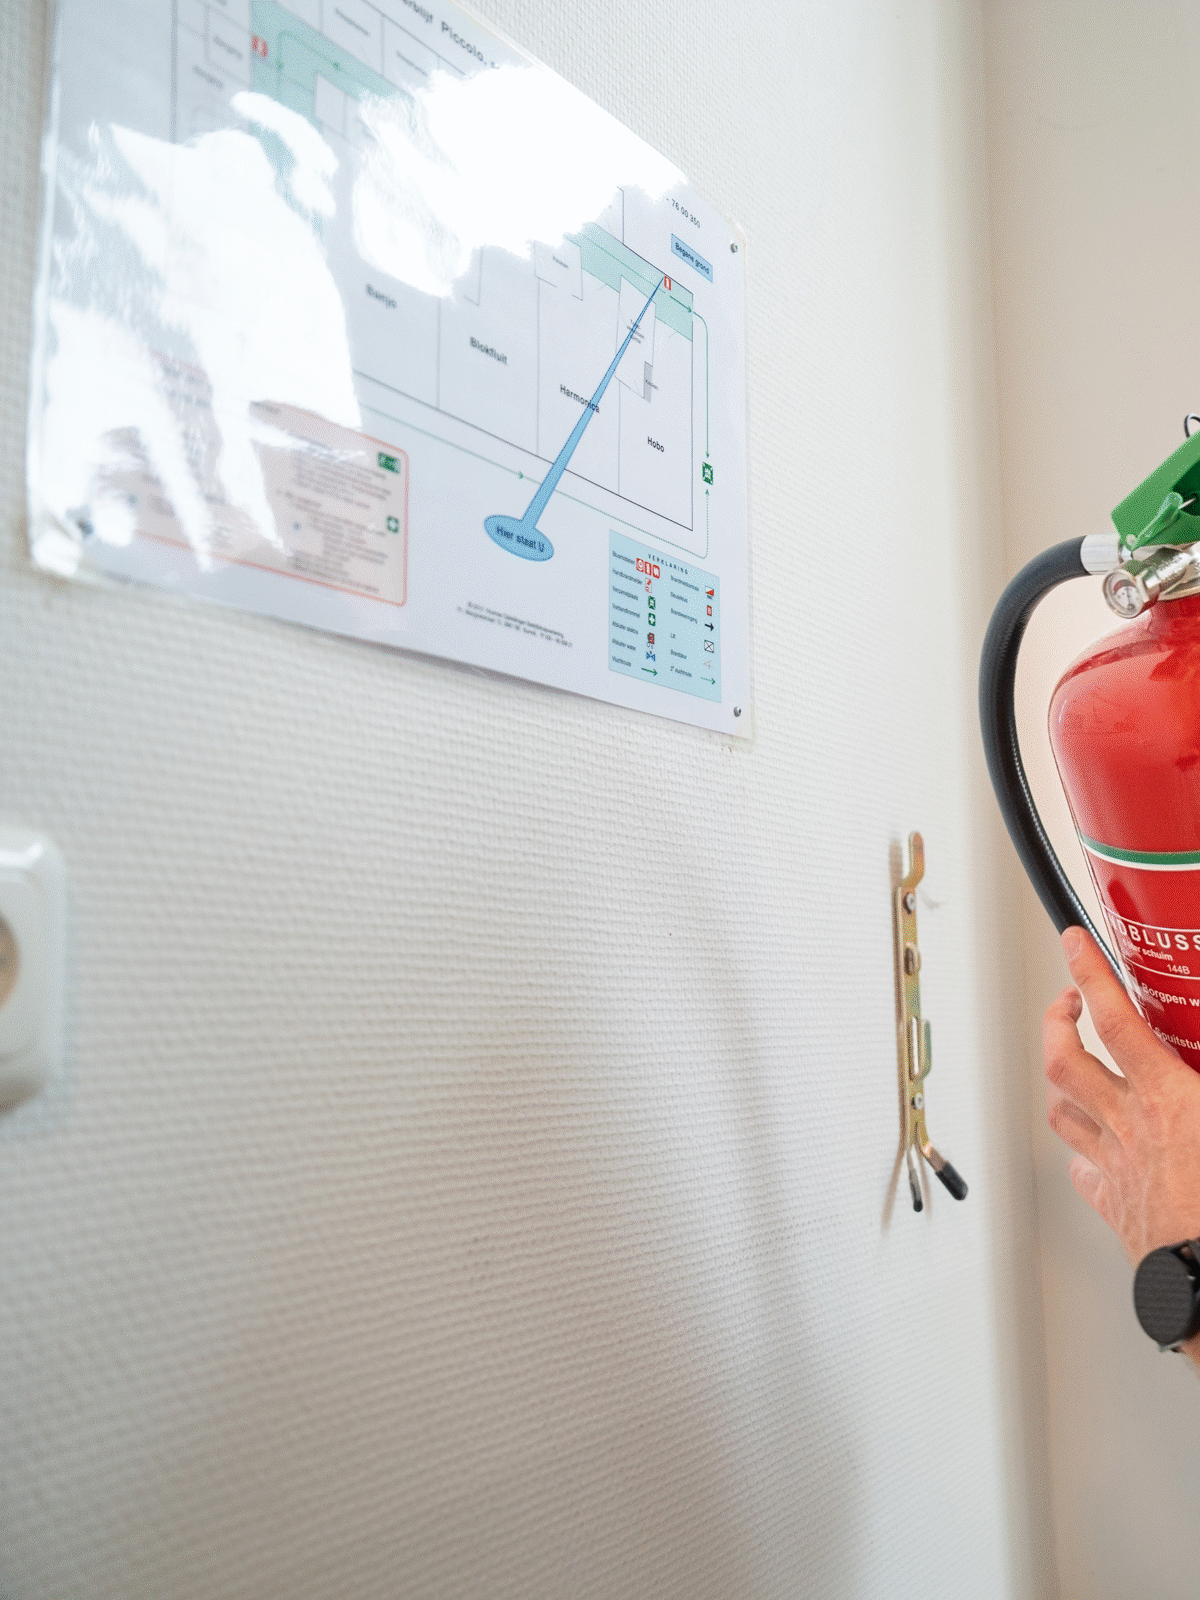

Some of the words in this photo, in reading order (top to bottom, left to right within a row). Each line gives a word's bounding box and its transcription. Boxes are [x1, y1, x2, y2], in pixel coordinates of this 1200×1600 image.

[469, 335, 508, 366] Blokfluit
[559, 383, 600, 414] Harmonica
[647, 436, 665, 453] Hobo
[496, 525, 513, 540] Hier
[516, 534, 536, 550] staat
[647, 553, 689, 575] VERKLARING
[1142, 947, 1174, 962] schuim
[1167, 963, 1191, 975] 144B
[1141, 982, 1187, 1006] Borgpen
